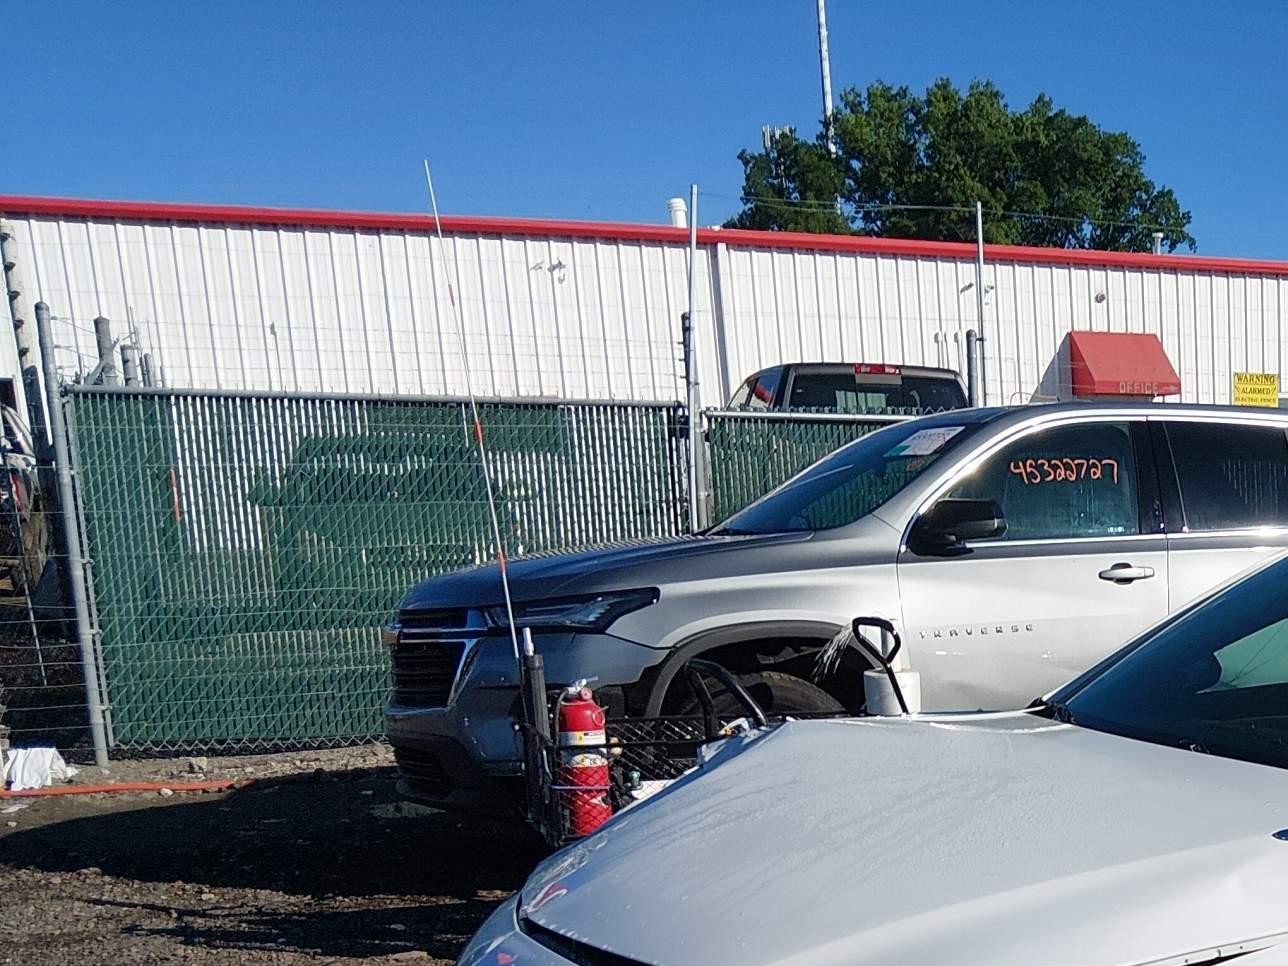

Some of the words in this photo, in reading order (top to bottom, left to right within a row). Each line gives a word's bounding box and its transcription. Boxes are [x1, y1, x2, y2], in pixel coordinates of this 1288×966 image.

[1236, 373, 1275, 384] WARNING
[1119, 382, 1159, 395] OFFICE
[1241, 387, 1271, 395] ALARMED
[1010, 458, 1118, 485] 45322727
[919, 624, 1033, 639] TRAVERSE
